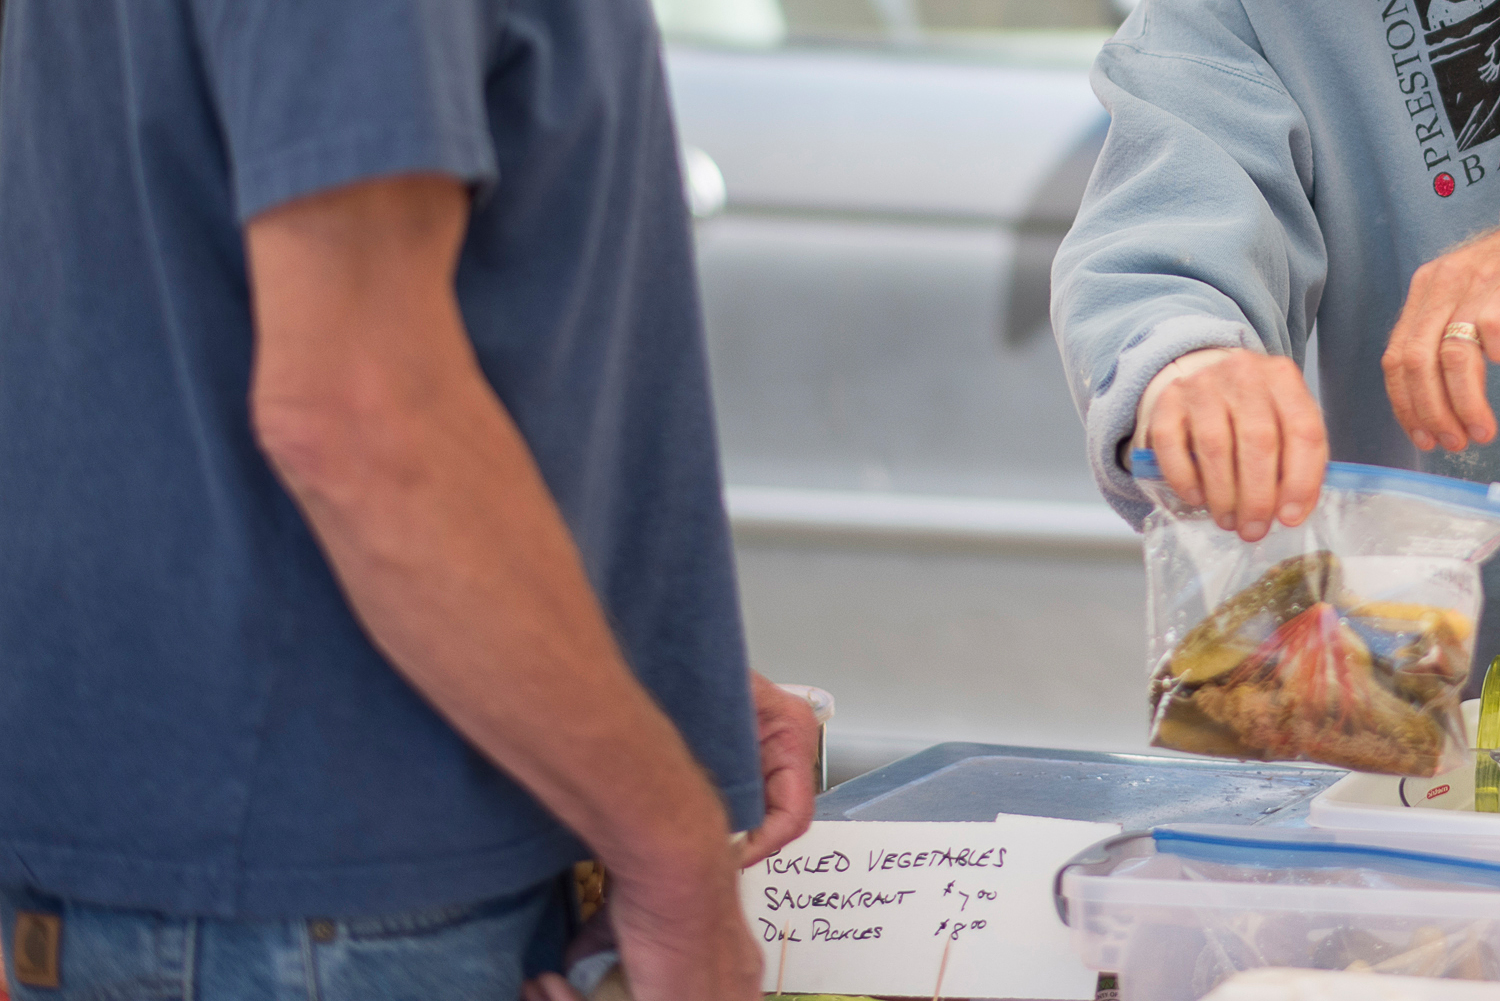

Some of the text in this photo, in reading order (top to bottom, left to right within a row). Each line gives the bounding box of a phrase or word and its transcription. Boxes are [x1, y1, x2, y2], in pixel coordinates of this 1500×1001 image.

[741, 847, 1007, 876] ICKLED VEGETABLES
[764, 886, 916, 911] SAUERKRAUT
